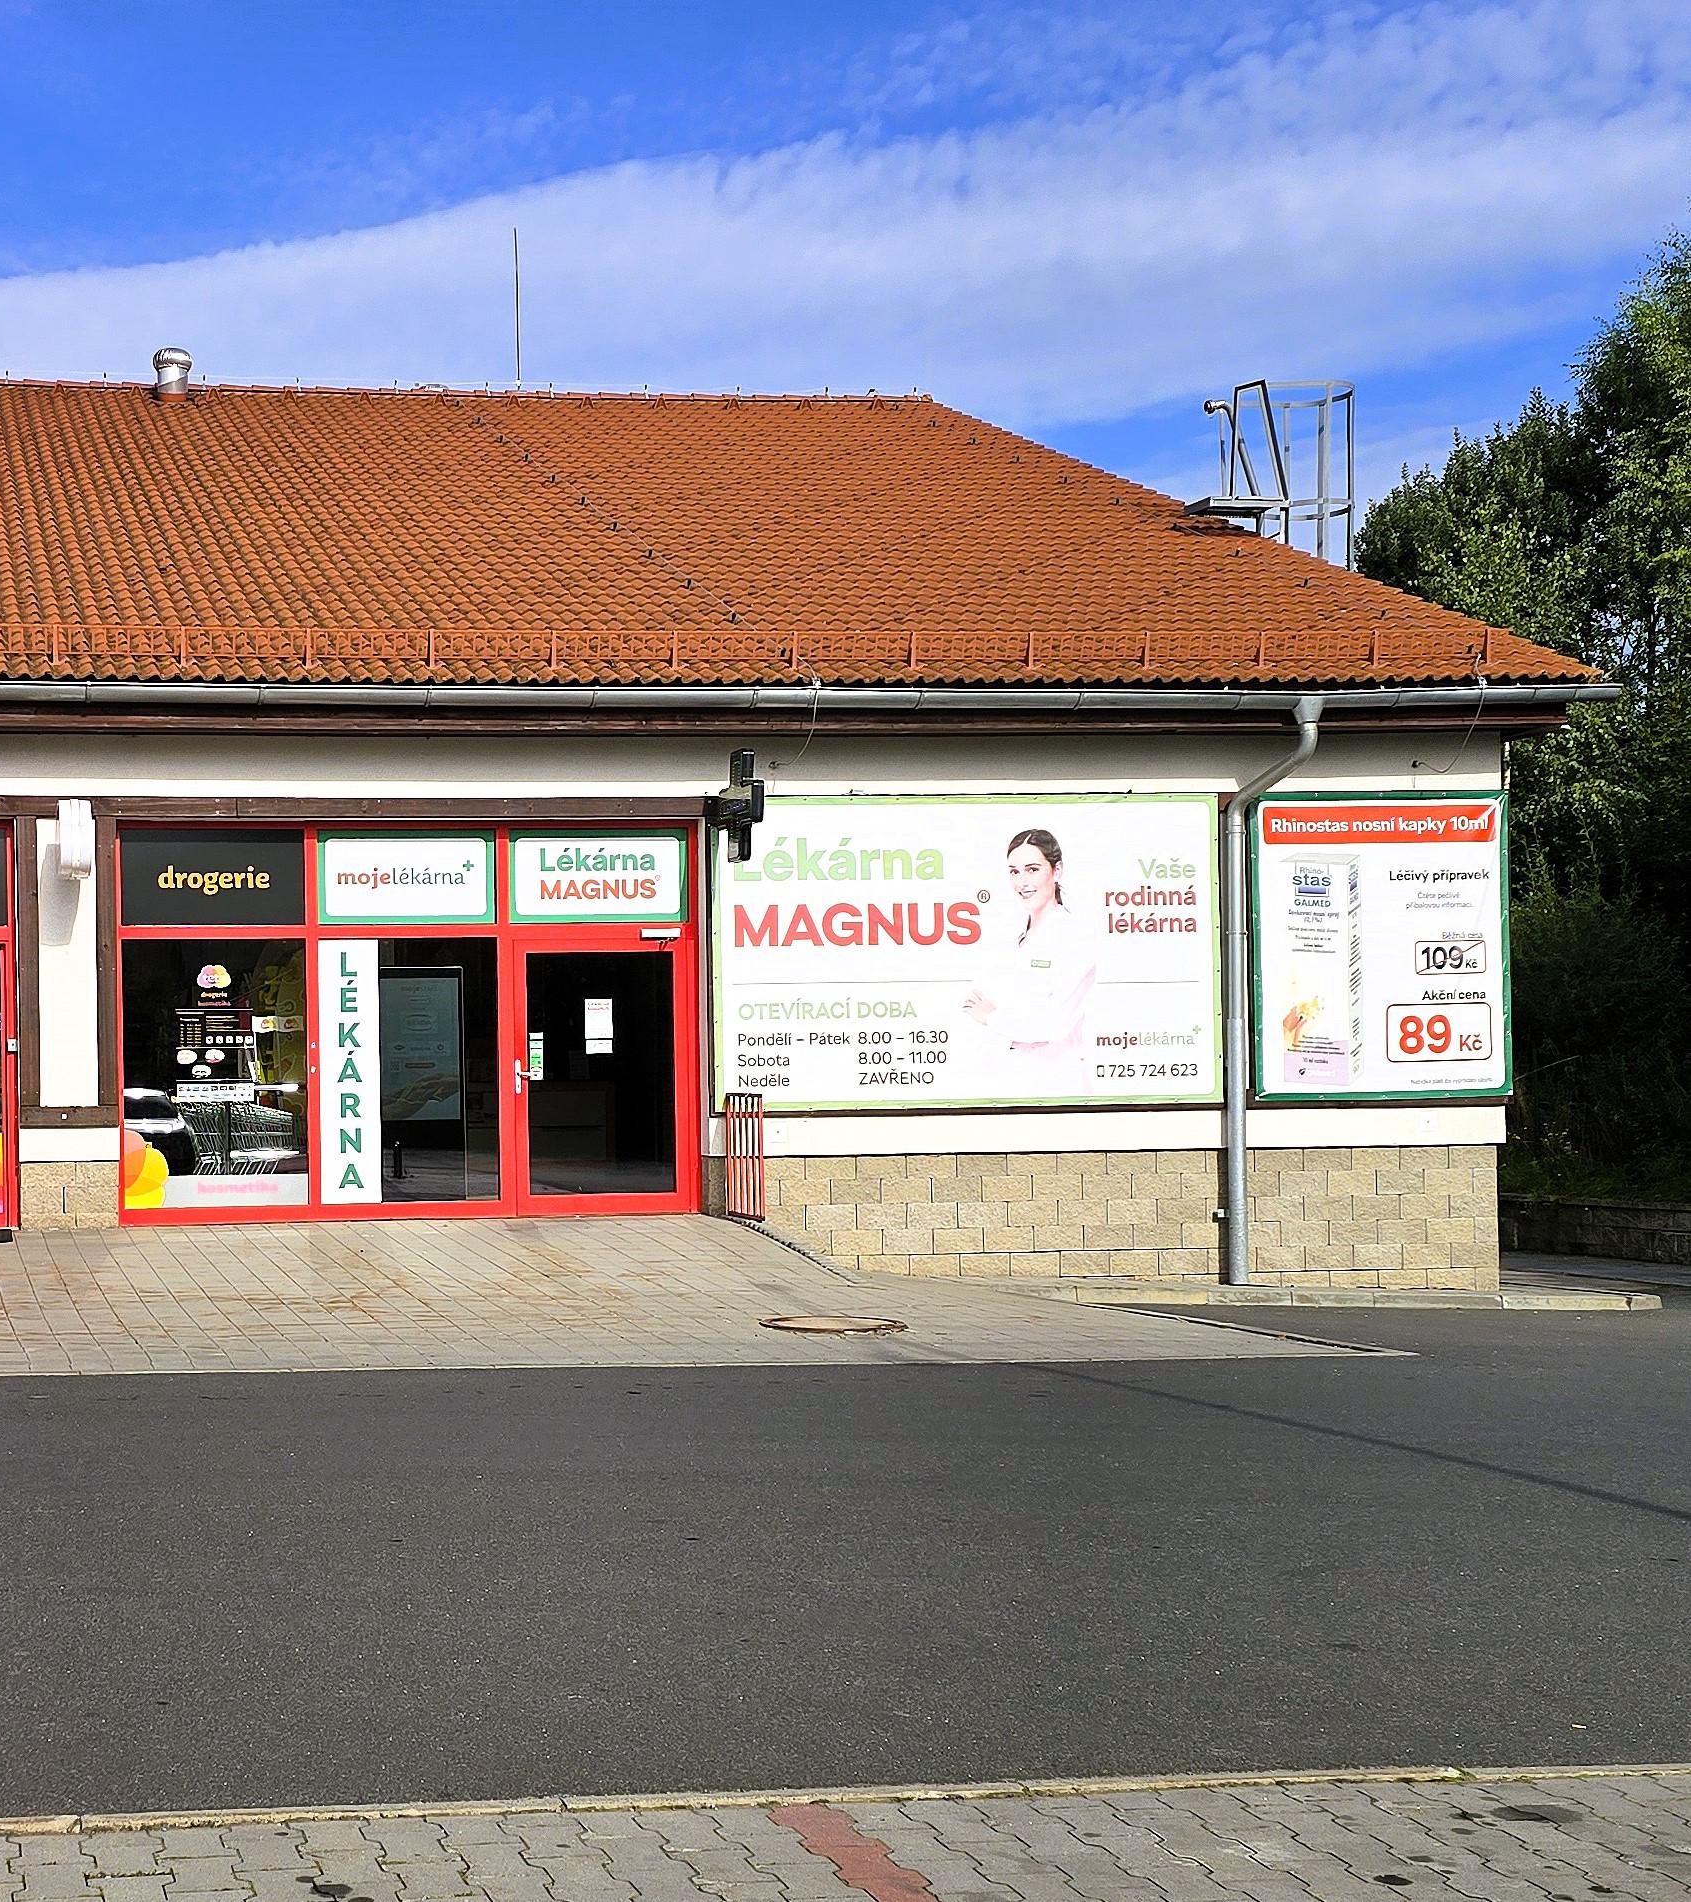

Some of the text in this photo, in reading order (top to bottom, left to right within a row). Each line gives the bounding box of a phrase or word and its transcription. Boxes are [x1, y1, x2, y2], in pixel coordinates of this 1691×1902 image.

[1271, 814, 1489, 835] Rhinostas nosní kapky 10ml
[540, 847, 655, 872] Lékárna
[1138, 858, 1197, 879] Vaše
[157, 866, 270, 895] drogerie
[337, 867, 465, 889] mojelékárna
[1292, 874, 1331, 886] stas
[1390, 868, 1489, 883] Léčivý přípravek
[540, 878, 657, 900] MAGNUS
[1105, 885, 1198, 907] rodinná
[1294, 899, 1331, 907] GALMED
[1108, 912, 1198, 934] lékárna
[1421, 945, 1478, 970] 109 Kč
[1422, 989, 1486, 1000] Akční cena
[738, 998, 918, 1020] OTEVÍRACÍ DOBA
[737, 1033, 792, 1047] Pondělí
[809, 1032, 851, 1045] Pátek
[858, 1031, 892, 1044] 8.00
[909, 1030, 949, 1044] 16.30
[1096, 1032, 1196, 1050] mojelékárna
[1399, 1014, 1483, 1054] 89 Kč
[737, 1053, 791, 1067] Sobota
[858, 1051, 892, 1065] 8.00
[909, 1050, 947, 1064] 11.00
[738, 1069, 935, 1088] Neděle ZAVŘENO
[1109, 1063, 1199, 1077] 725 724 623
